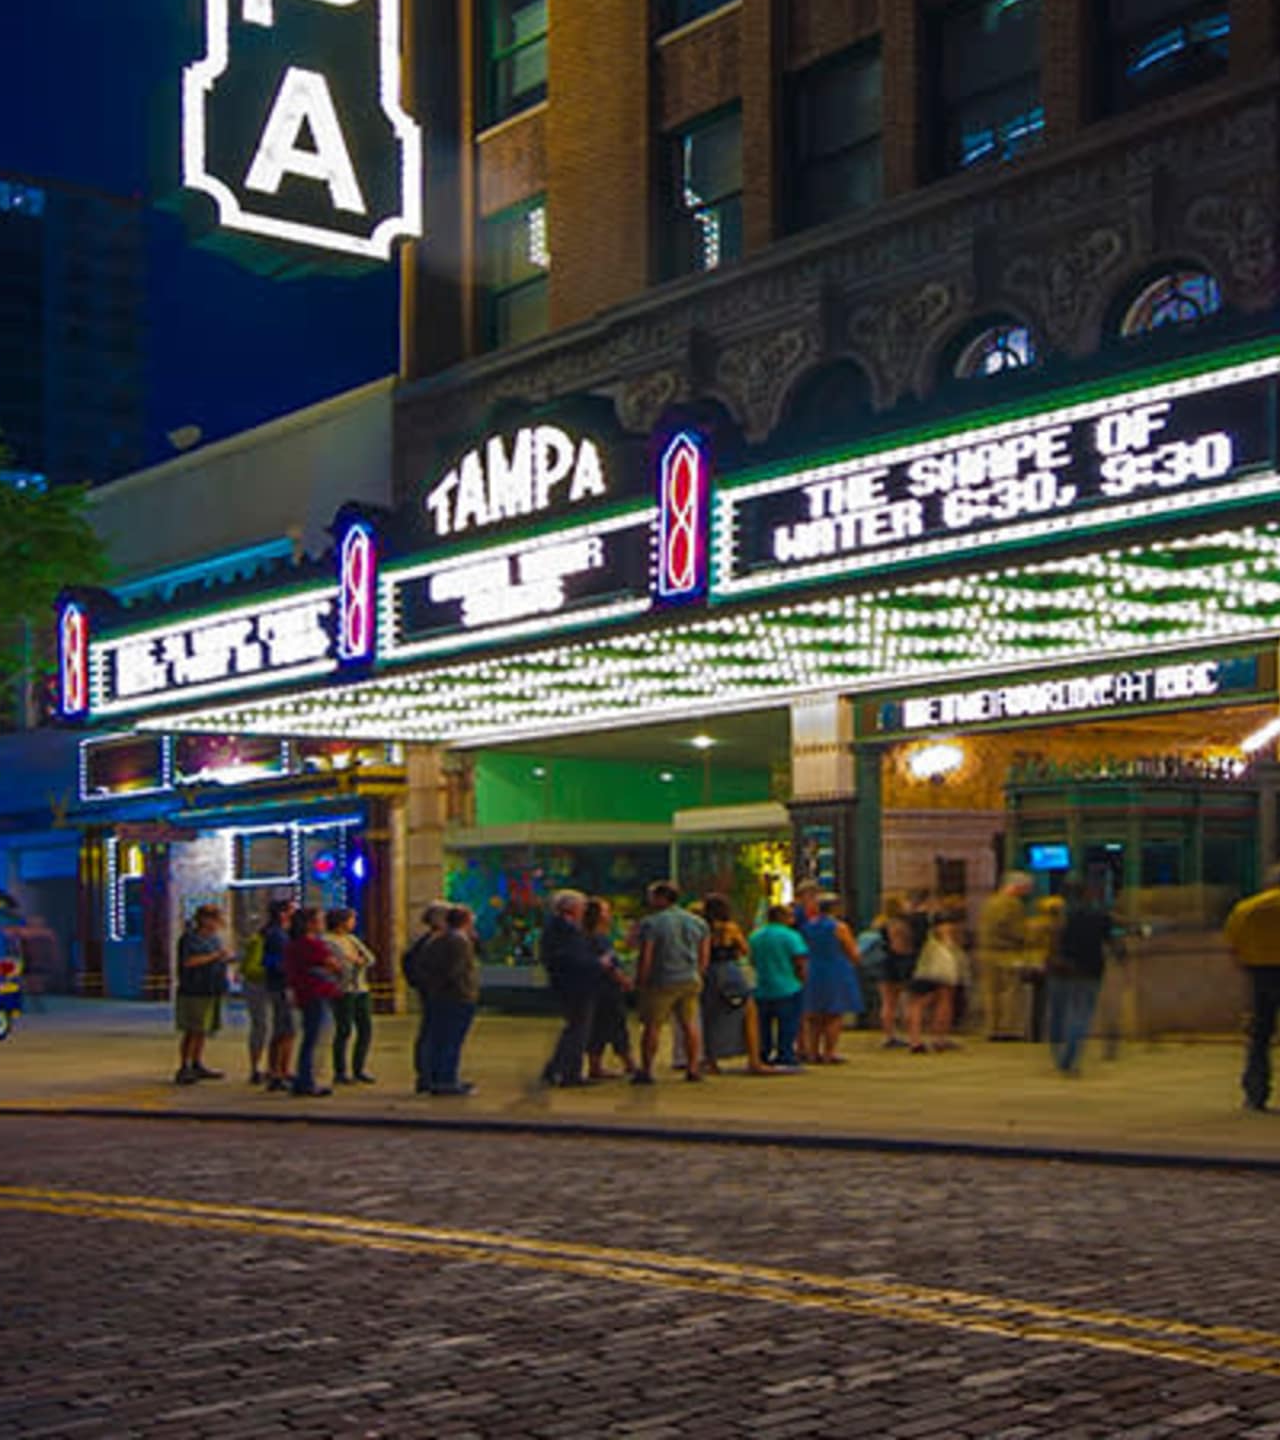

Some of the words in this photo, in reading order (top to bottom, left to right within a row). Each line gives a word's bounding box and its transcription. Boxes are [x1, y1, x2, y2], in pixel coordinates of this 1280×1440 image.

[427, 425, 606, 535] TAMPA
[773, 498, 924, 561] WATER
[1101, 432, 1233, 496] 9:30
[804, 468, 889, 519] THE
[908, 426, 1072, 495] SHAPE
[1096, 402, 1170, 456] OF
